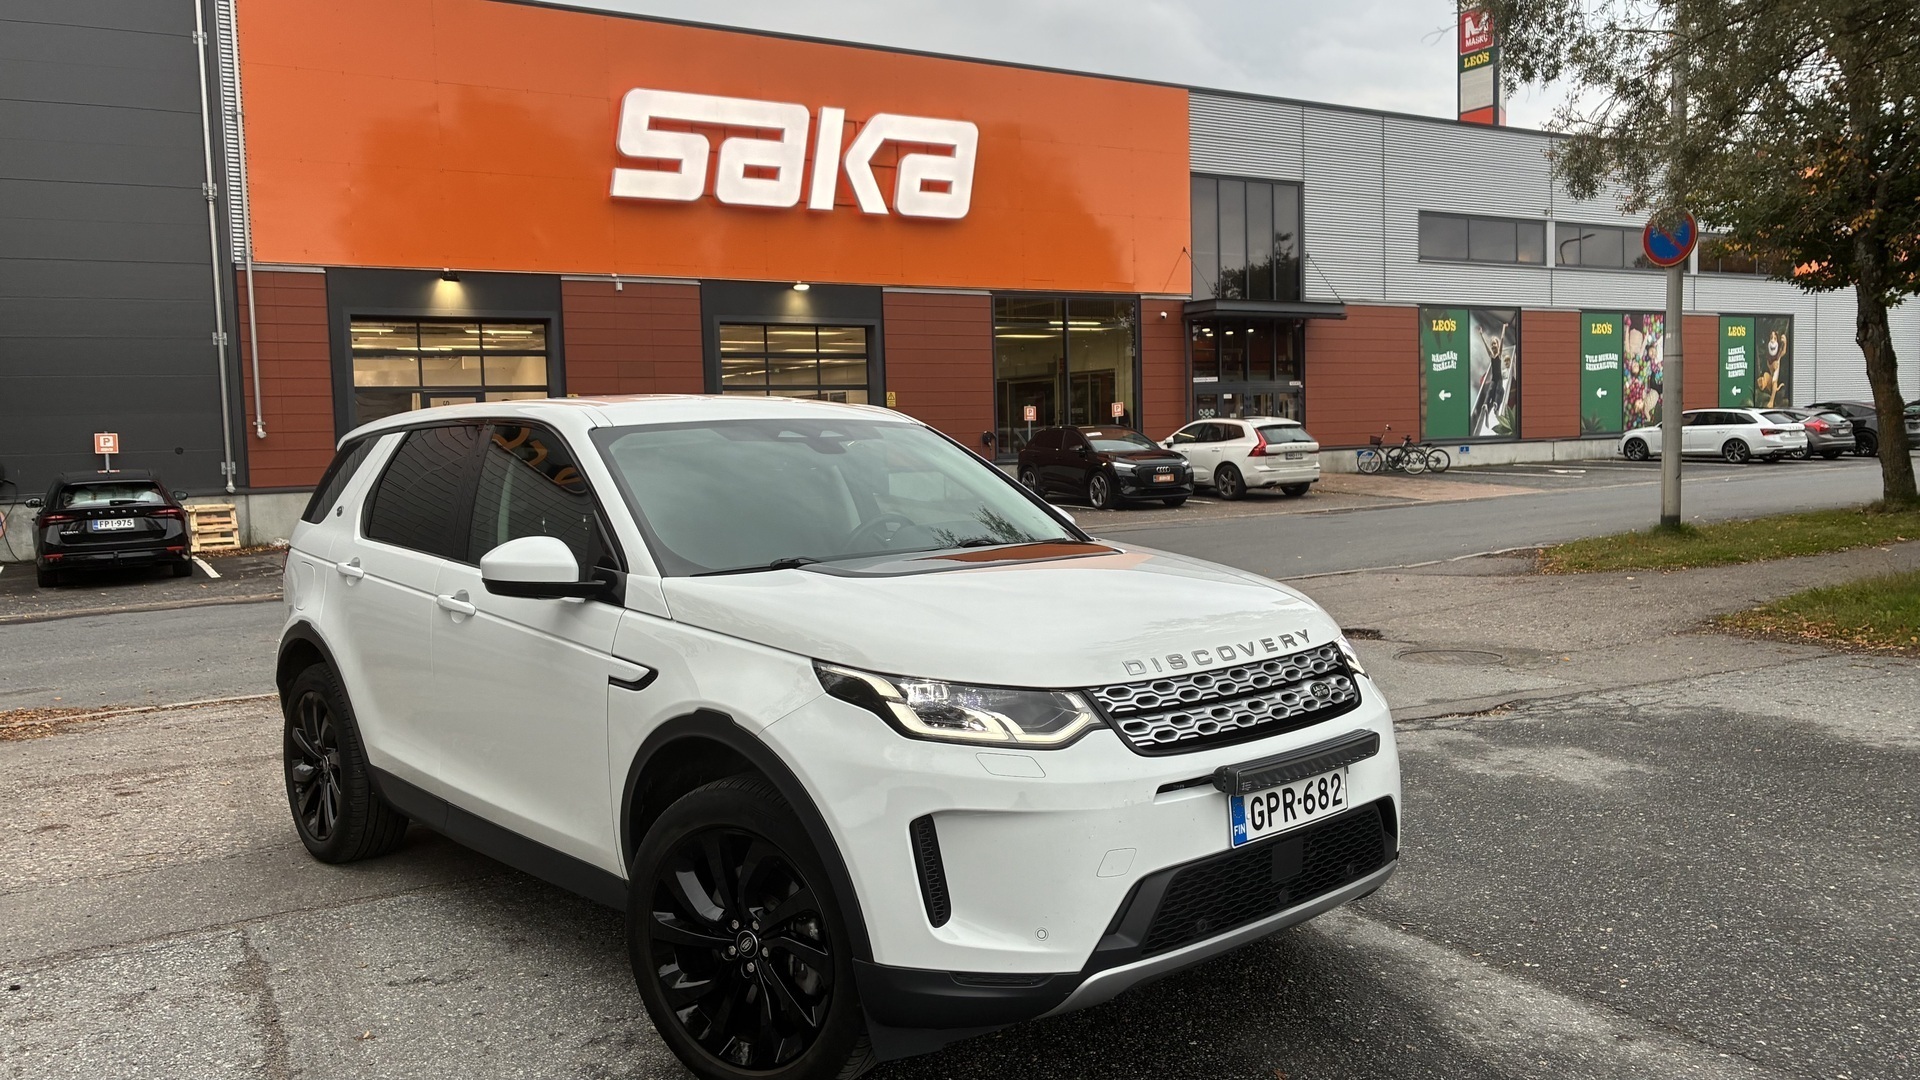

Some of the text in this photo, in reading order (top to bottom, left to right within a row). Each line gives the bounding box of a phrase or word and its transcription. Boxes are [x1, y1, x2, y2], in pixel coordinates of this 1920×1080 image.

[1464, 51, 1490, 68] LEO'S
[1432, 318, 1457, 332] LEO'S
[1591, 322, 1613, 335] LEO'S
[1728, 325, 1746, 337] LEO'S
[103, 437, 111, 446] P
[99, 519, 133, 528] FPI-975
[1122, 628, 1312, 677] DISCOVERY
[1250, 773, 1345, 832] GPR-682
[1233, 822, 1247, 837] FIN
